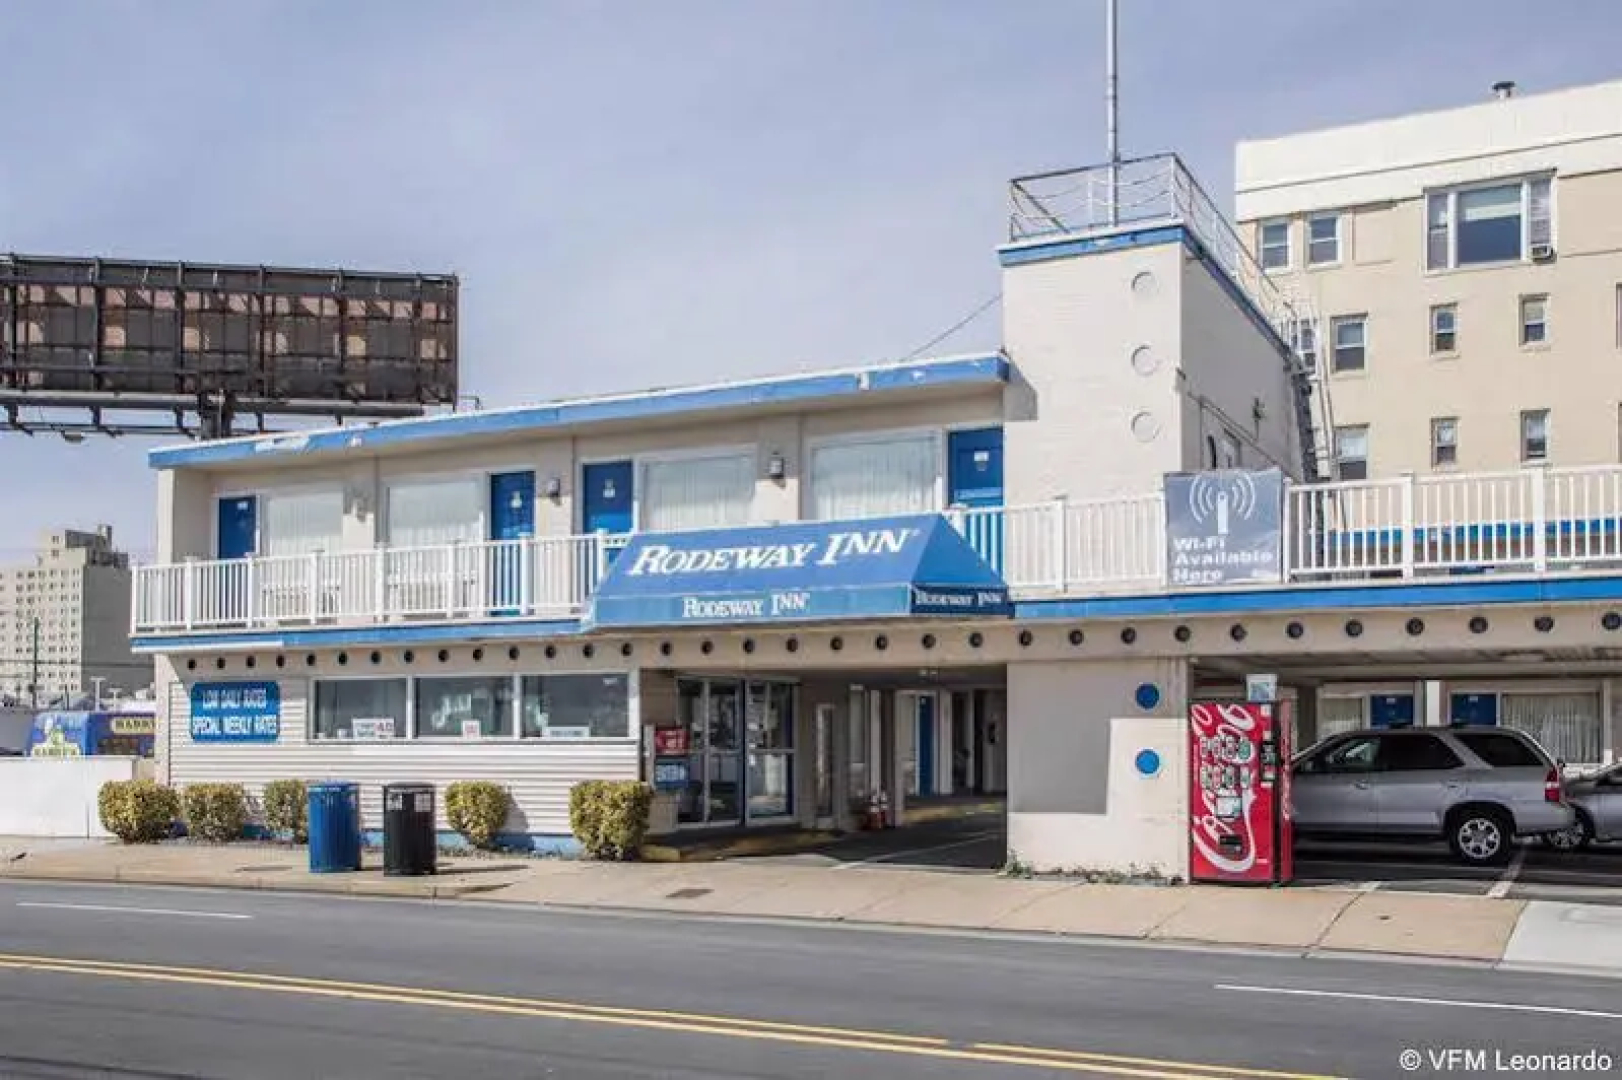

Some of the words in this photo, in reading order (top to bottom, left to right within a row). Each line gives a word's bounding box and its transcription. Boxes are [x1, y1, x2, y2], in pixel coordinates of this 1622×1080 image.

[625, 544, 818, 576] RODEWAY
[815, 528, 910, 566] INN
[1175, 550, 1274, 566] Available
[681, 596, 764, 618] RODEWAY
[770, 592, 810, 616] INN
